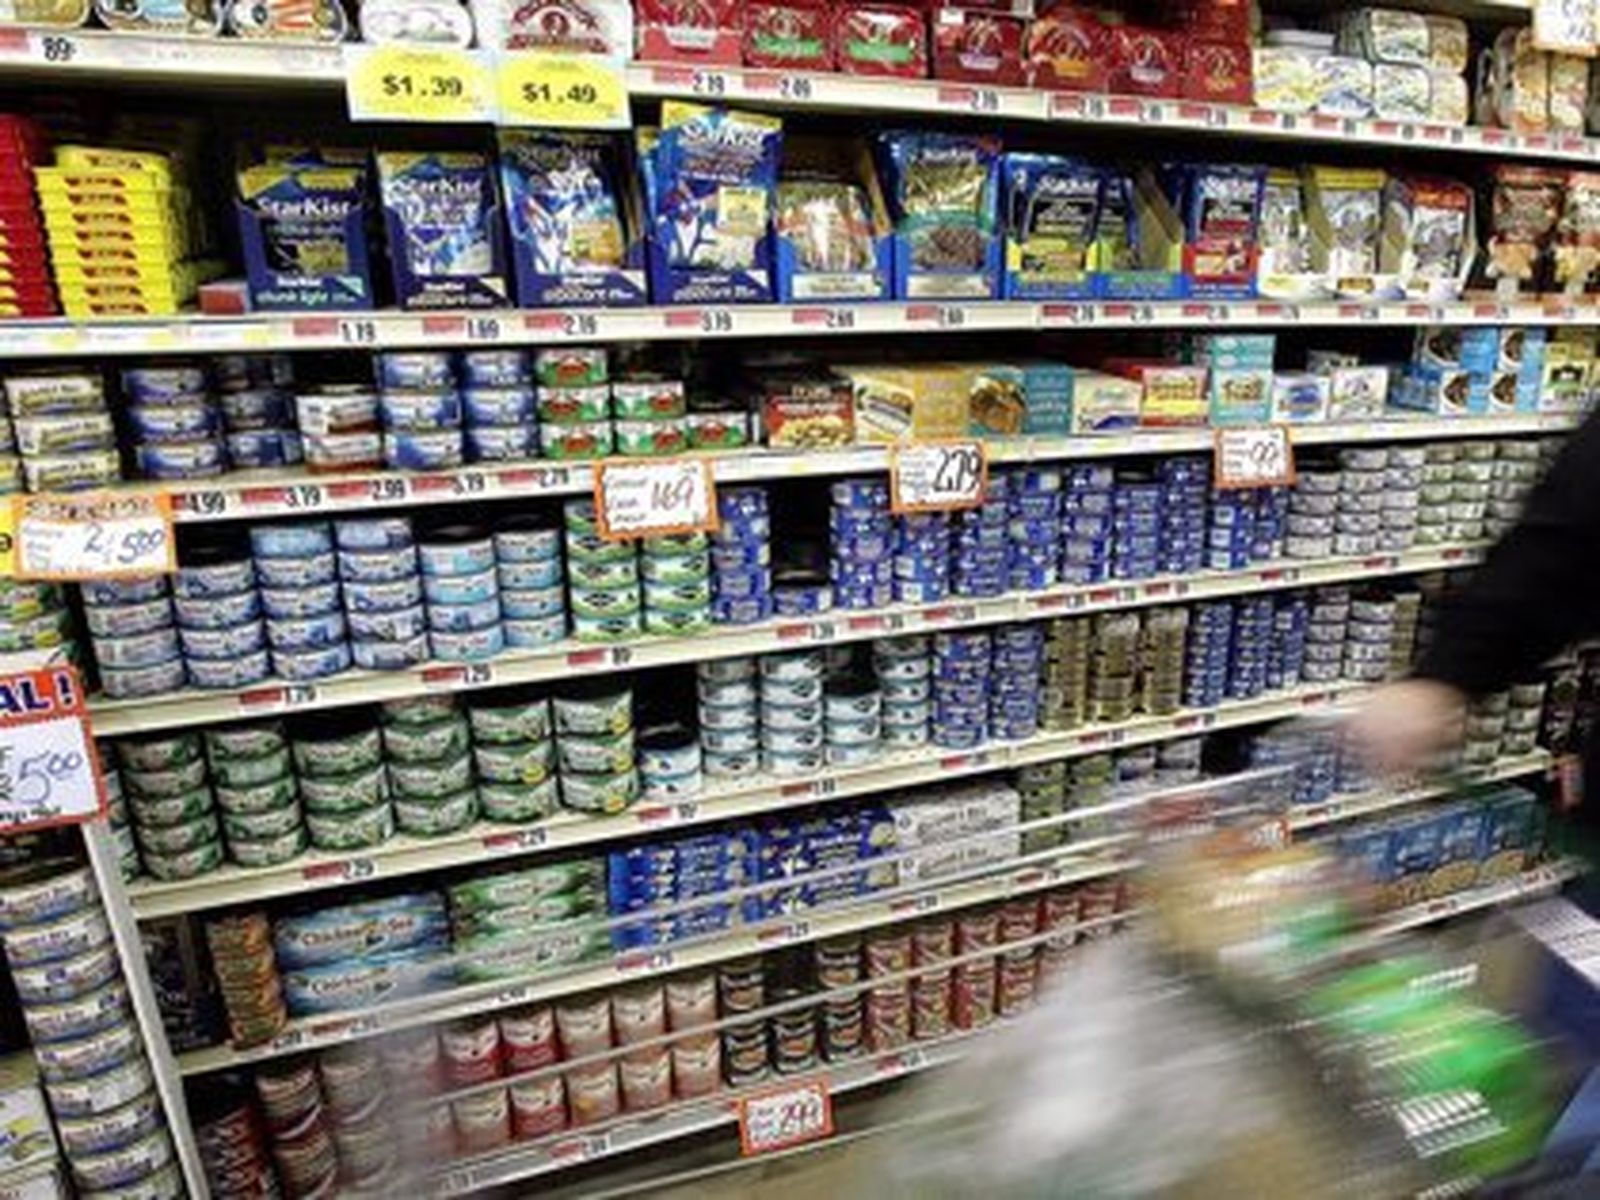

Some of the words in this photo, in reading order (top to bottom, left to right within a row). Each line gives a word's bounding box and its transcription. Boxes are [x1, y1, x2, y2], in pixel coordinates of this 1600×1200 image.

[381, 75, 463, 97] $1.39
[522, 82, 597, 103] $1.49
[257, 197, 350, 219] StarKist
